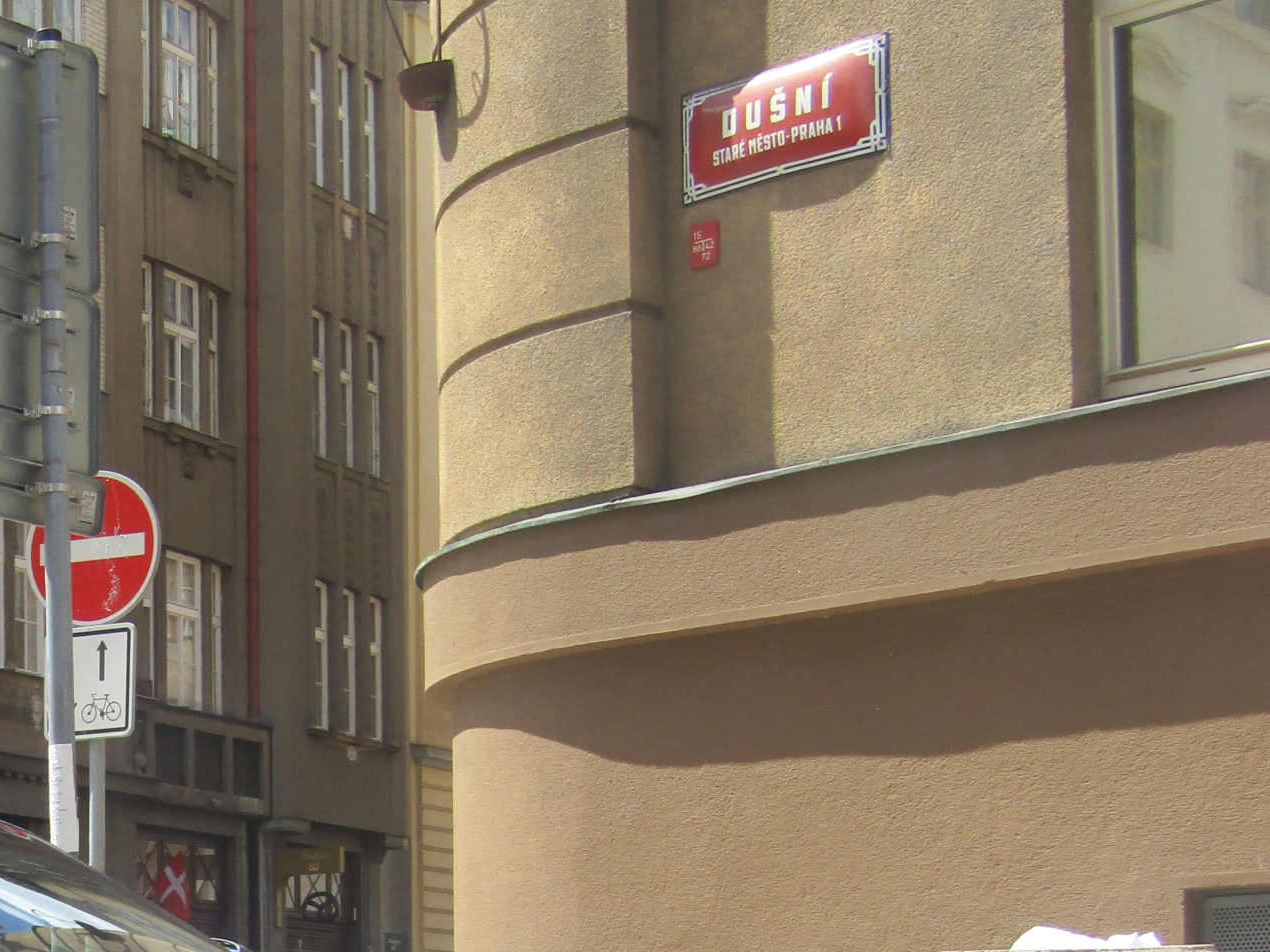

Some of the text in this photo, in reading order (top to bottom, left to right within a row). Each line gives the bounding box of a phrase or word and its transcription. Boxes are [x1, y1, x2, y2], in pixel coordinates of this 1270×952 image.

[722, 71, 833, 139] DUŠNÍ
[713, 139, 746, 167] STARÉ
[835, 115, 842, 132] 1
